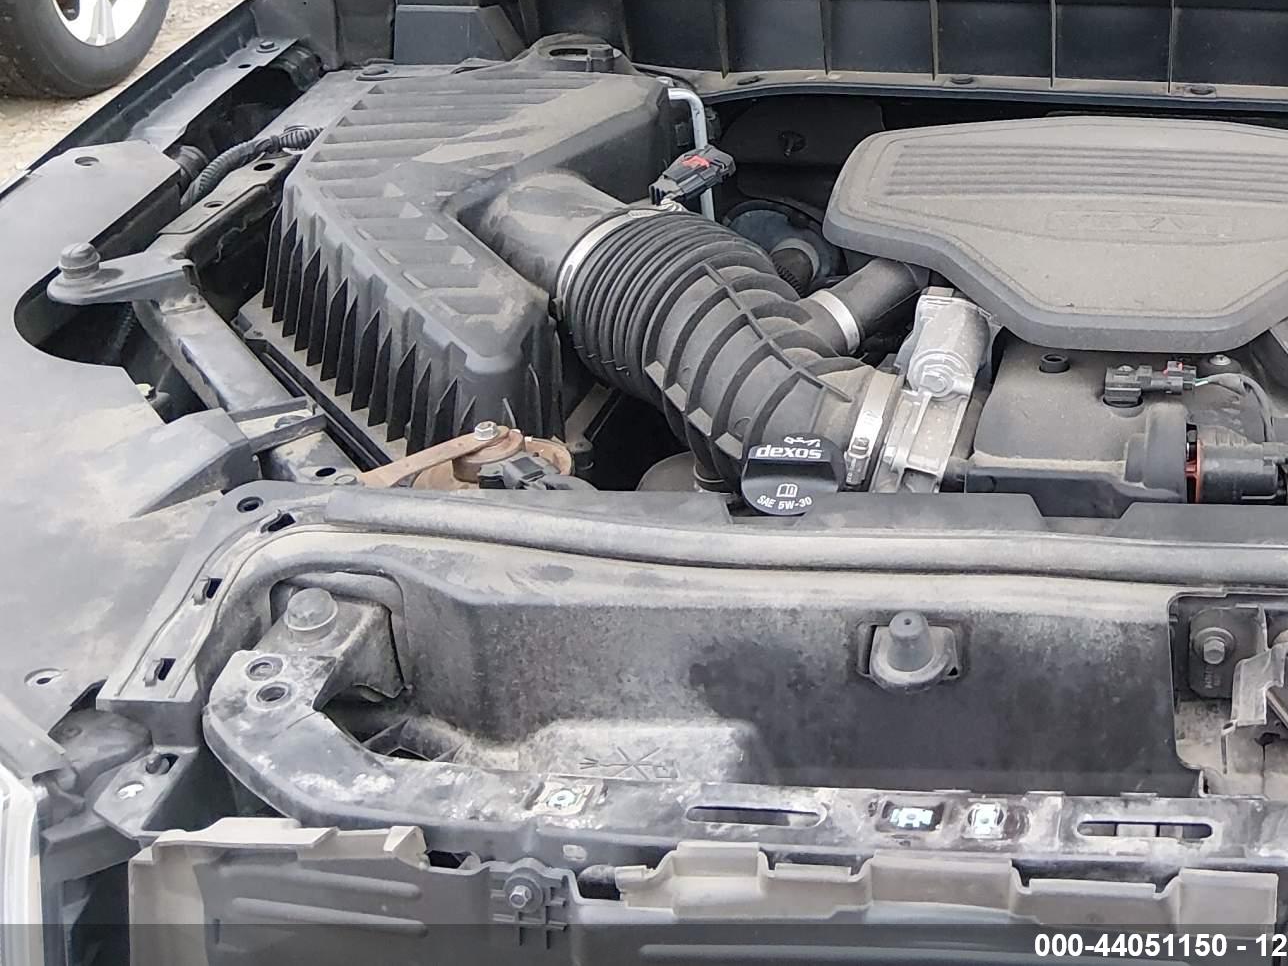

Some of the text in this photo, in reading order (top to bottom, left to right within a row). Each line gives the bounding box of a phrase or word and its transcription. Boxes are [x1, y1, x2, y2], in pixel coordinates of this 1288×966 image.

[756, 444, 823, 459] dexos
[756, 495, 812, 510] SAE 5W-30
